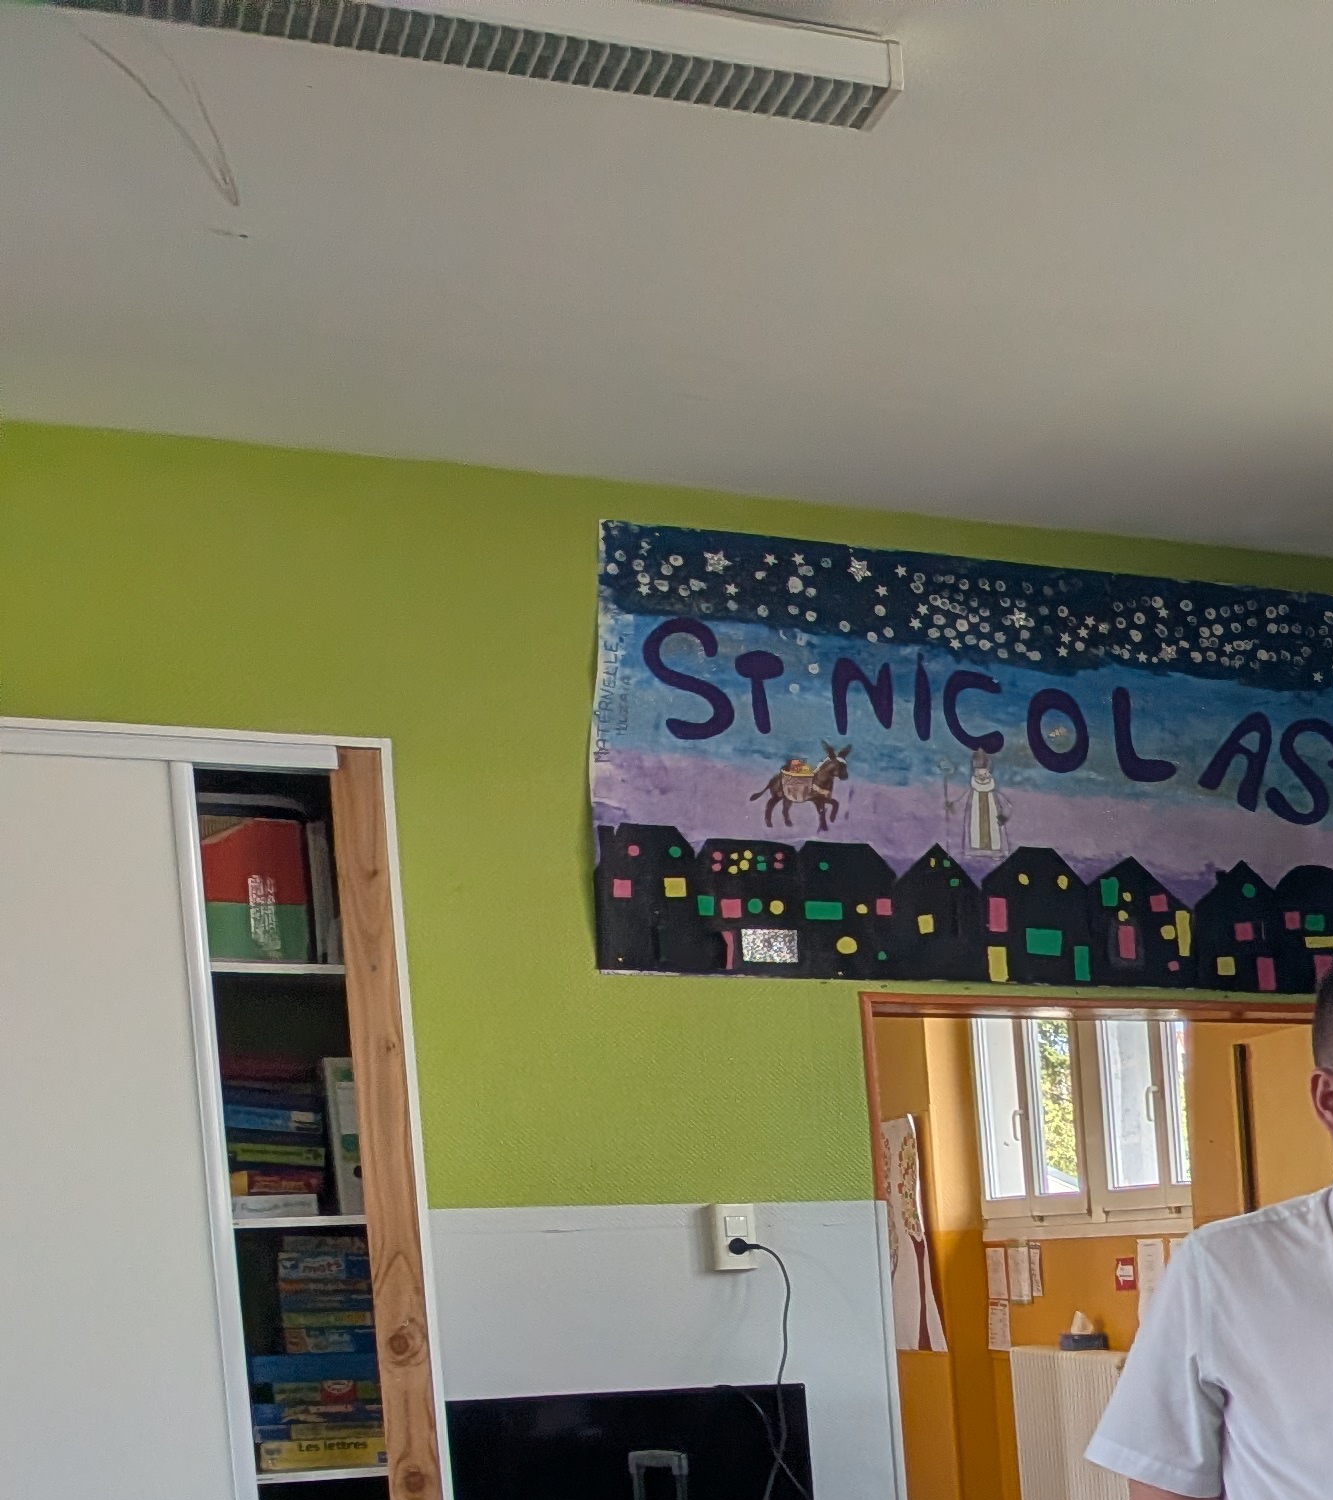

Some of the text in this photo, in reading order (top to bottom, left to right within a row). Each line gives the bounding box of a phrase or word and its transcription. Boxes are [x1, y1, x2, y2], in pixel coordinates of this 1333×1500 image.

[593, 640, 619, 763] MATERNELLE
[298, 1440, 368, 1452] Les lettres
